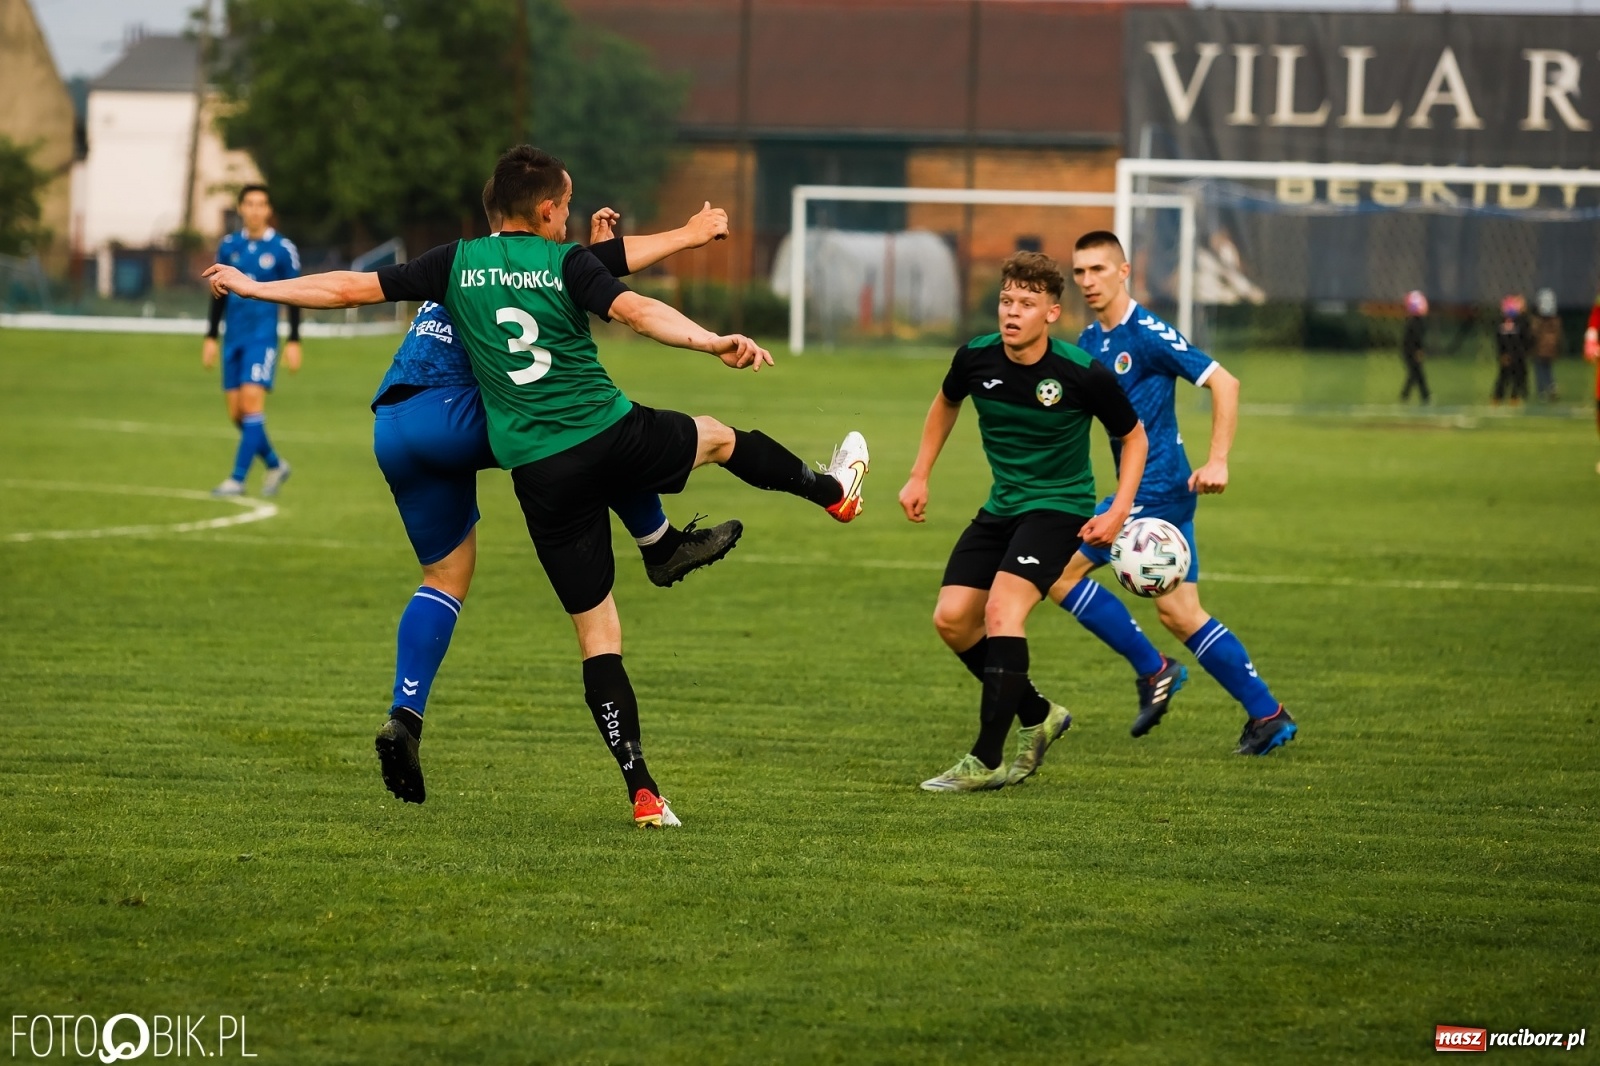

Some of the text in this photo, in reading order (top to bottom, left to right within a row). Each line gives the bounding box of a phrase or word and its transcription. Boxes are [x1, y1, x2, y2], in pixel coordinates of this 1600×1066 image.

[1146, 41, 1600, 132] VILLA R
[460, 269, 486, 288] LKS
[495, 306, 552, 386] 3
